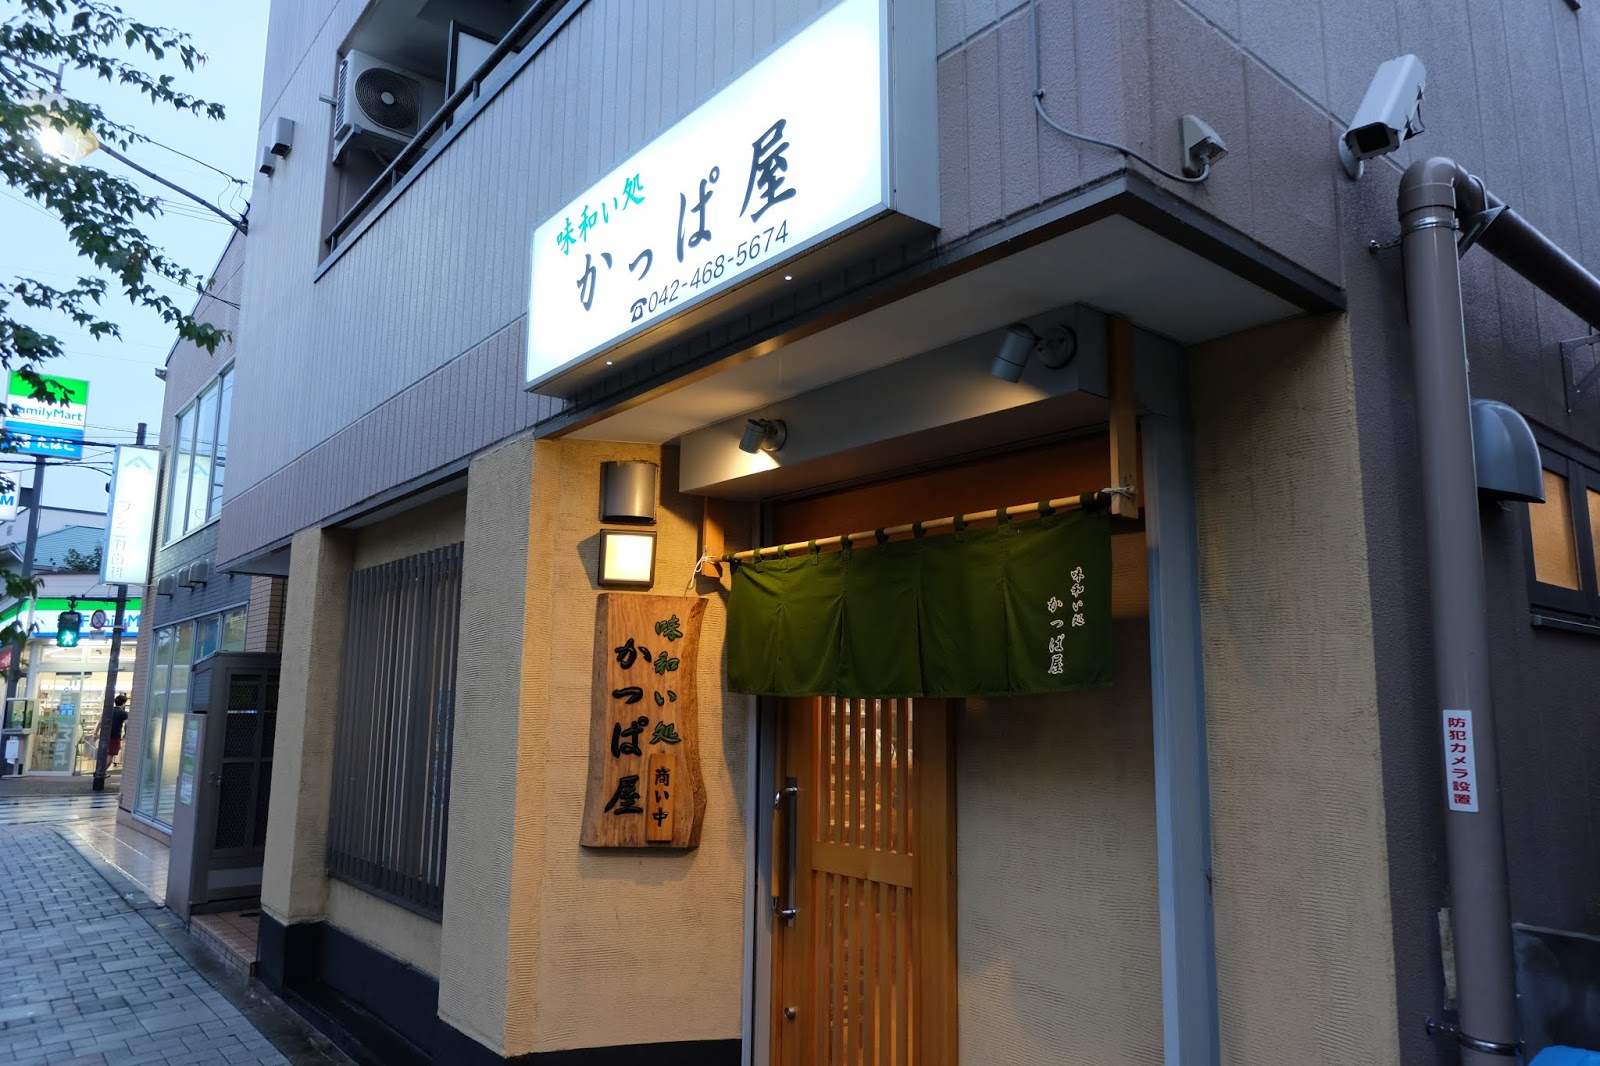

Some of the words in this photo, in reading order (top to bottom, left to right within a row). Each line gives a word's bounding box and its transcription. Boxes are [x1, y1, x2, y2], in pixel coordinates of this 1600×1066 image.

[555, 173, 646, 256] 味和い処
[576, 118, 797, 311] かっぱ屋
[648, 219, 789, 312] 042-468-5674
[1047, 596, 1066, 675] かっぱ屋
[1070, 566, 1086, 627] 味和い処
[649, 614, 684, 745] 味和い処
[652, 766, 671, 828] 商い中
[1447, 717, 1471, 805] 防犯カメラ設置
